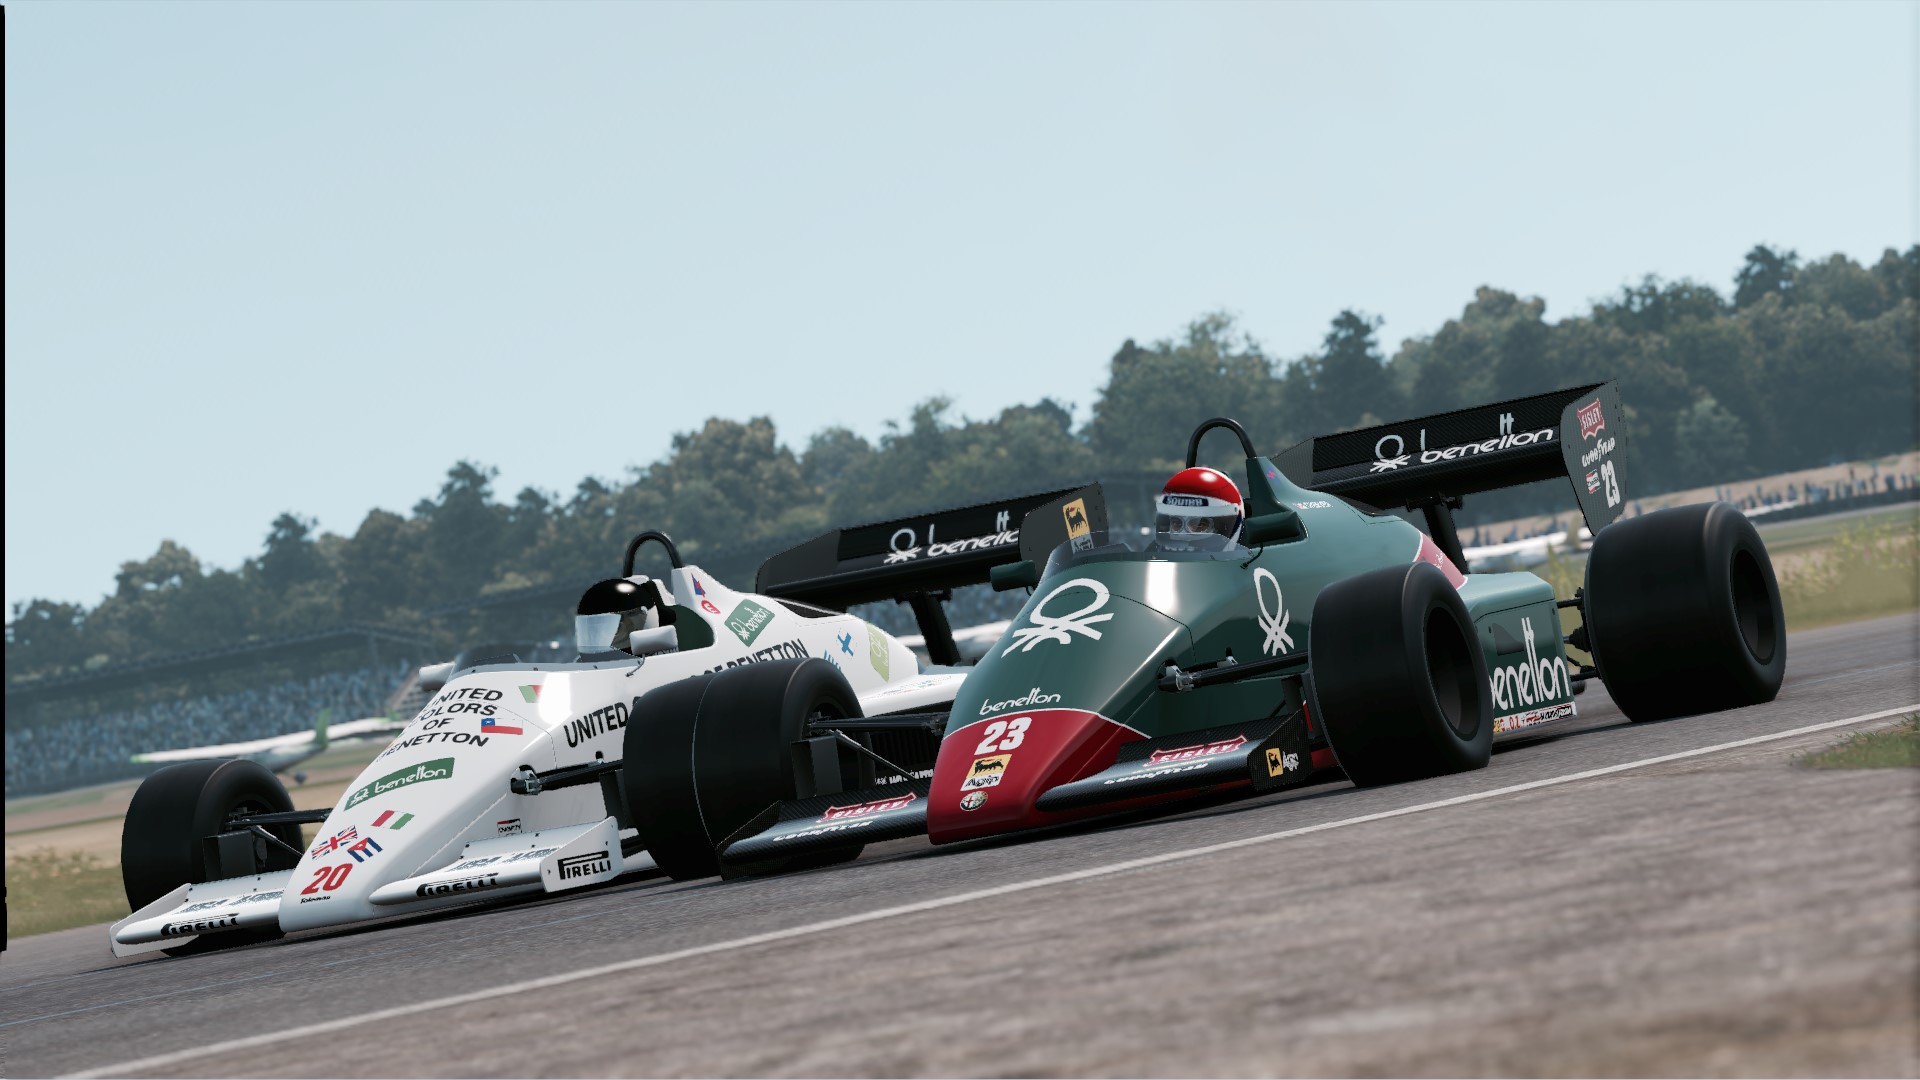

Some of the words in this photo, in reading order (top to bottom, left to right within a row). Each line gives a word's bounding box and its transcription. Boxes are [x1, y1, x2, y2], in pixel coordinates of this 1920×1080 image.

[1582, 407, 1601, 430] SISLEY
[1420, 412, 1553, 464] benetton
[1601, 460, 1620, 508] 23
[928, 510, 1019, 557] benetto
[1489, 617, 1570, 711] enetton
[411, 702, 498, 727] OLORS
[979, 687, 1061, 716] benetton
[422, 718, 455, 731] OF
[563, 702, 628, 748] UNITED
[974, 716, 1033, 756] 23
[374, 765, 447, 793] benetton
[300, 863, 353, 895] 20
[557, 850, 611, 880] PIRELLI
[416, 873, 498, 897] PIRELLI
[161, 913, 239, 936] PIRELLI
